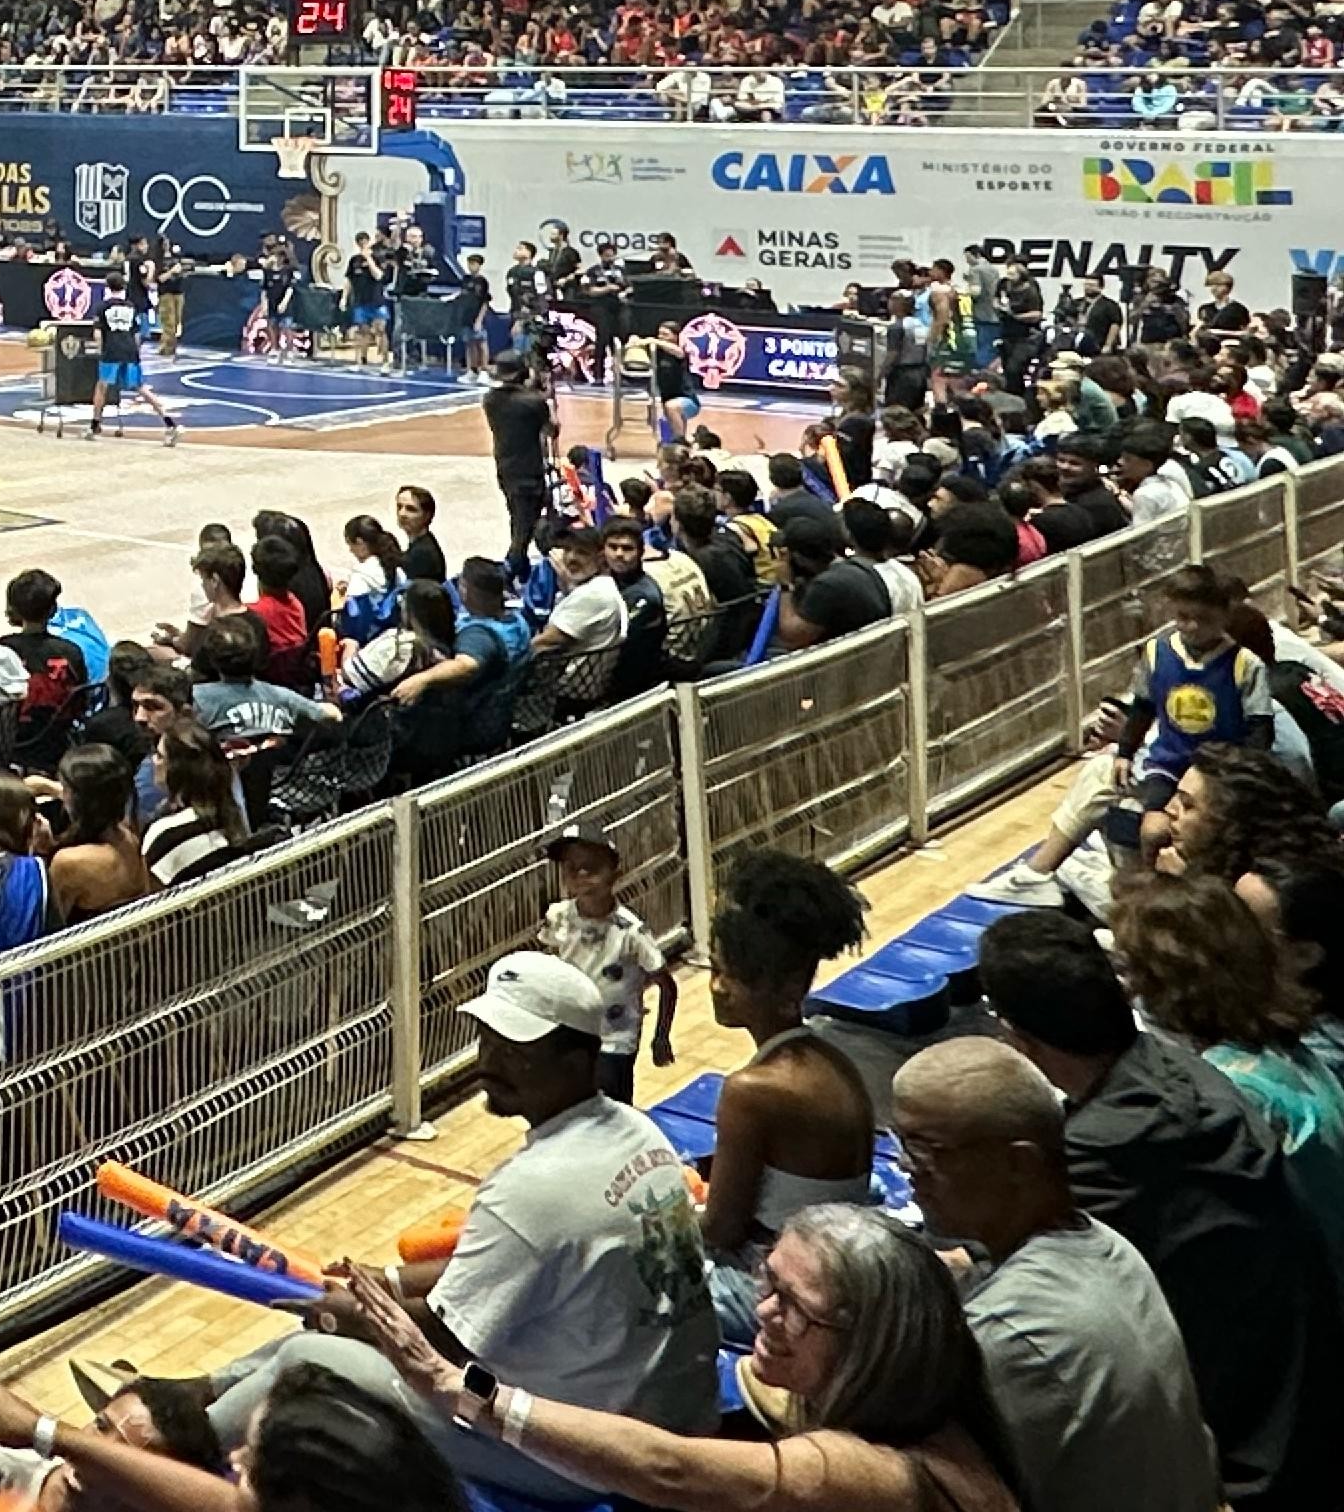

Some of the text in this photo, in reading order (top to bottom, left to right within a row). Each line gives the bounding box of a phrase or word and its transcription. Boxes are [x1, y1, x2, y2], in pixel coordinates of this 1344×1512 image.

[297, 2, 345, 33] 24
[388, 94, 411, 125] 24
[1100, 140, 1276, 155] GOVERNO FEDERAL
[711, 152, 897, 196] CAIXA
[1039, 163, 1054, 175] DO
[976, 180, 1053, 192] ESPORTE
[1083, 157, 1294, 206] BRASIL
[579, 230, 664, 253] copas
[758, 230, 840, 249] MINAS
[758, 249, 853, 270] GERAIS
[765, 338, 838, 356] 3 PONTO
